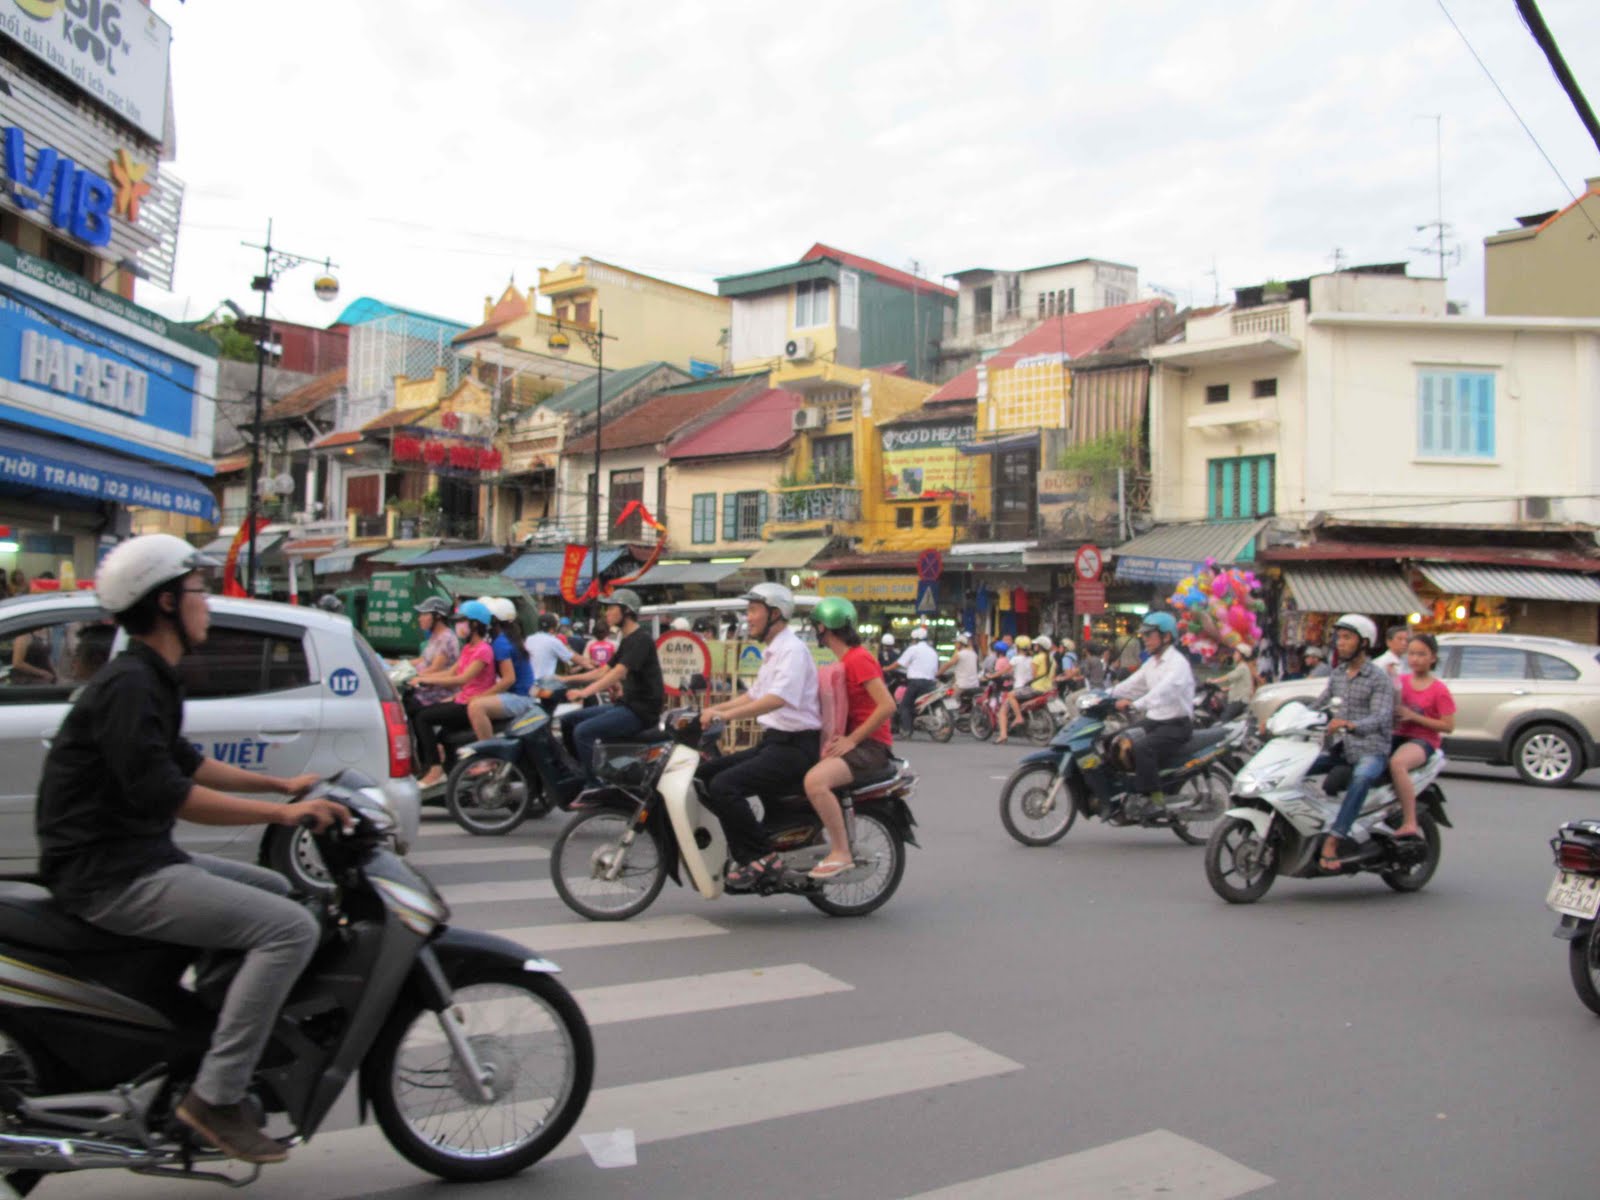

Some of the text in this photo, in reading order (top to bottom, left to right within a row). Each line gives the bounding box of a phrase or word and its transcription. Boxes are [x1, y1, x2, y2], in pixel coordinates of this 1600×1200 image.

[5, 126, 113, 248] VIB
[103, 479, 129, 499] 102
[332, 676, 358, 692] 117
